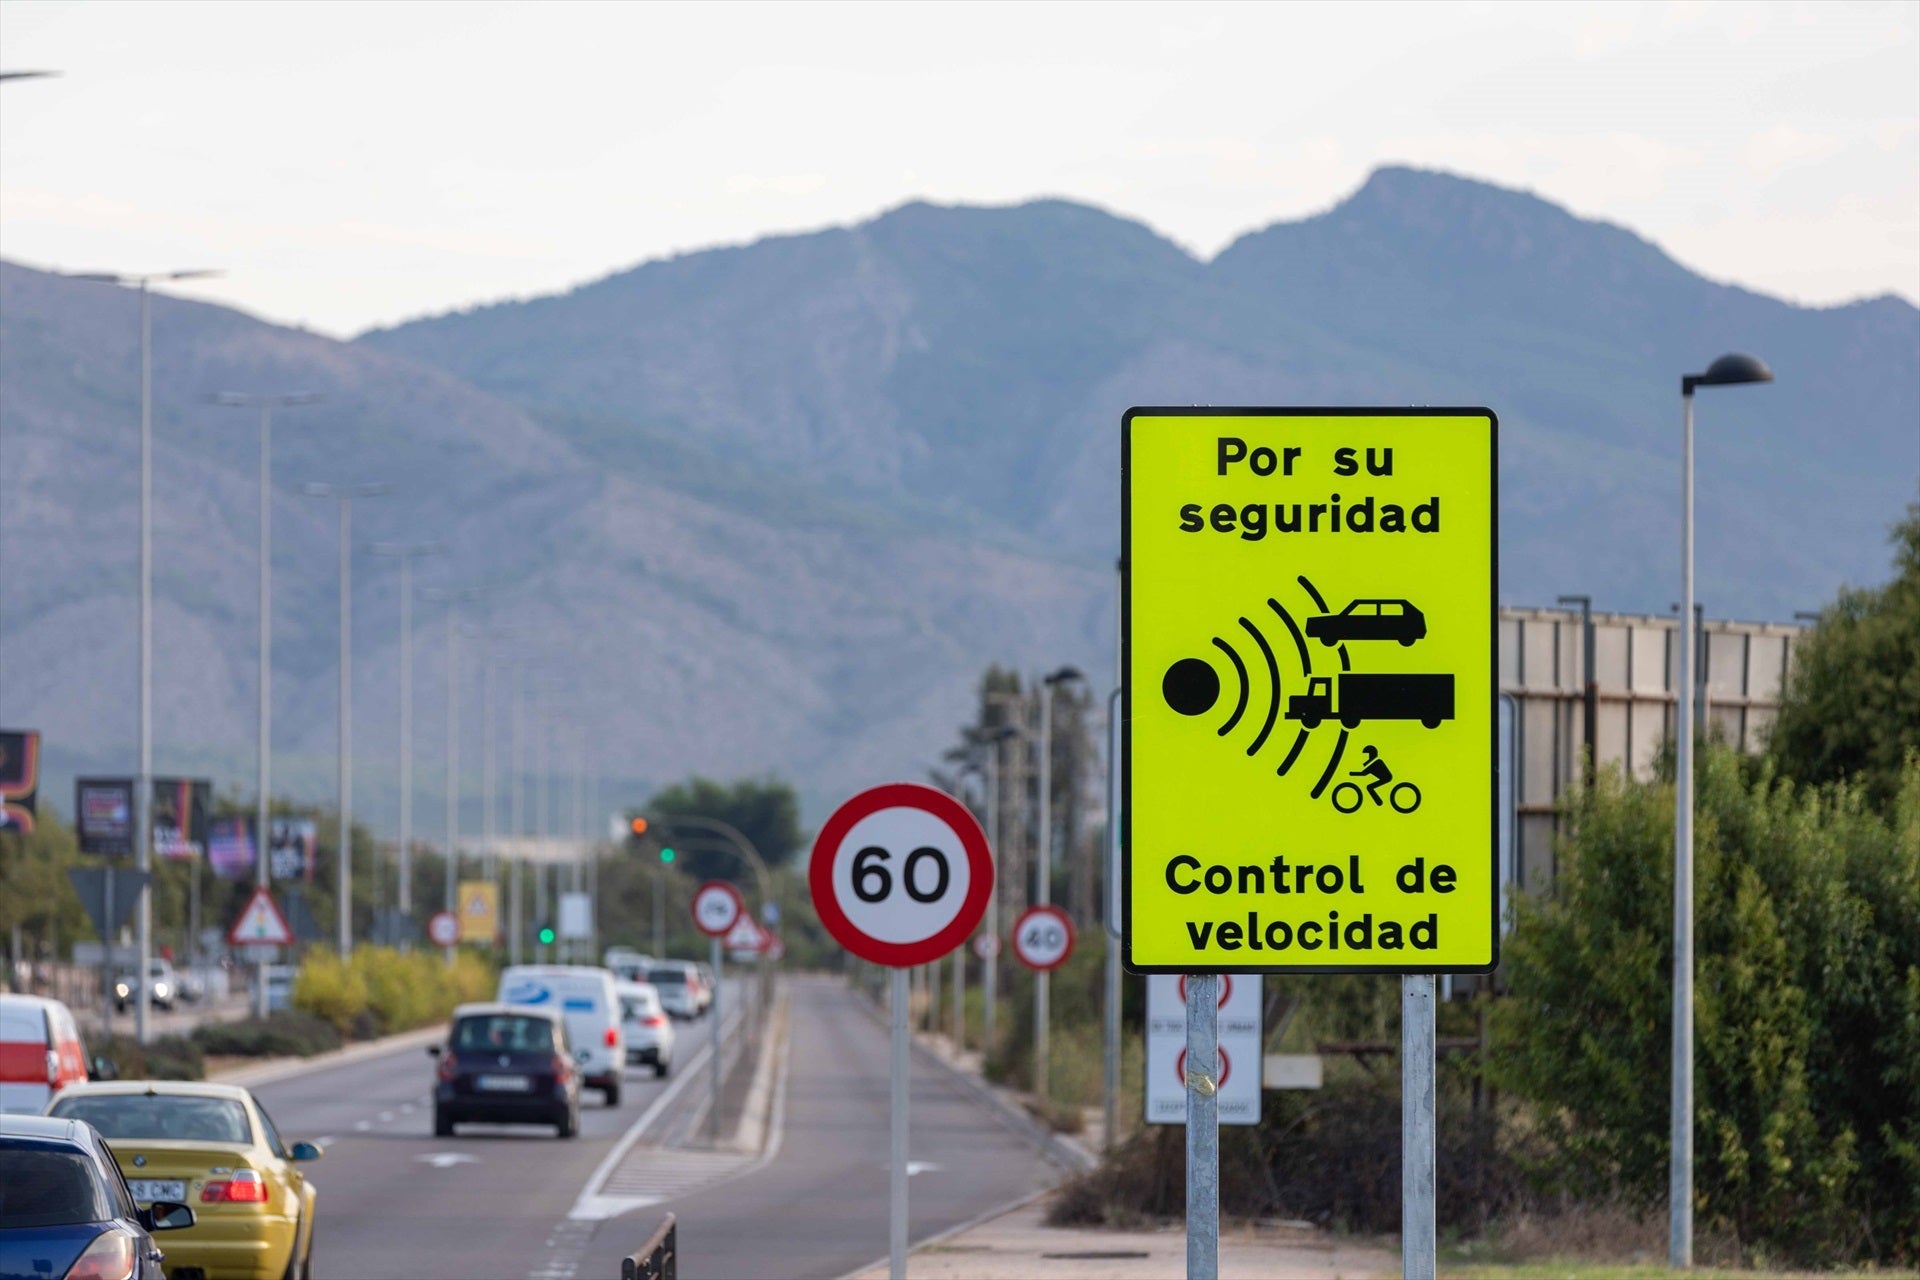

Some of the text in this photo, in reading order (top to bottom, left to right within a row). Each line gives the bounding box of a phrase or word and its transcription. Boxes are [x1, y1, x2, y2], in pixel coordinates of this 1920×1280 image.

[1217, 437, 1393, 477] Por su
[1179, 493, 1440, 542] seguridad
[851, 846, 950, 904] 60
[1165, 854, 1457, 895] Control de
[1024, 927, 1063, 951] 40
[1185, 910, 1438, 951] velocidad
